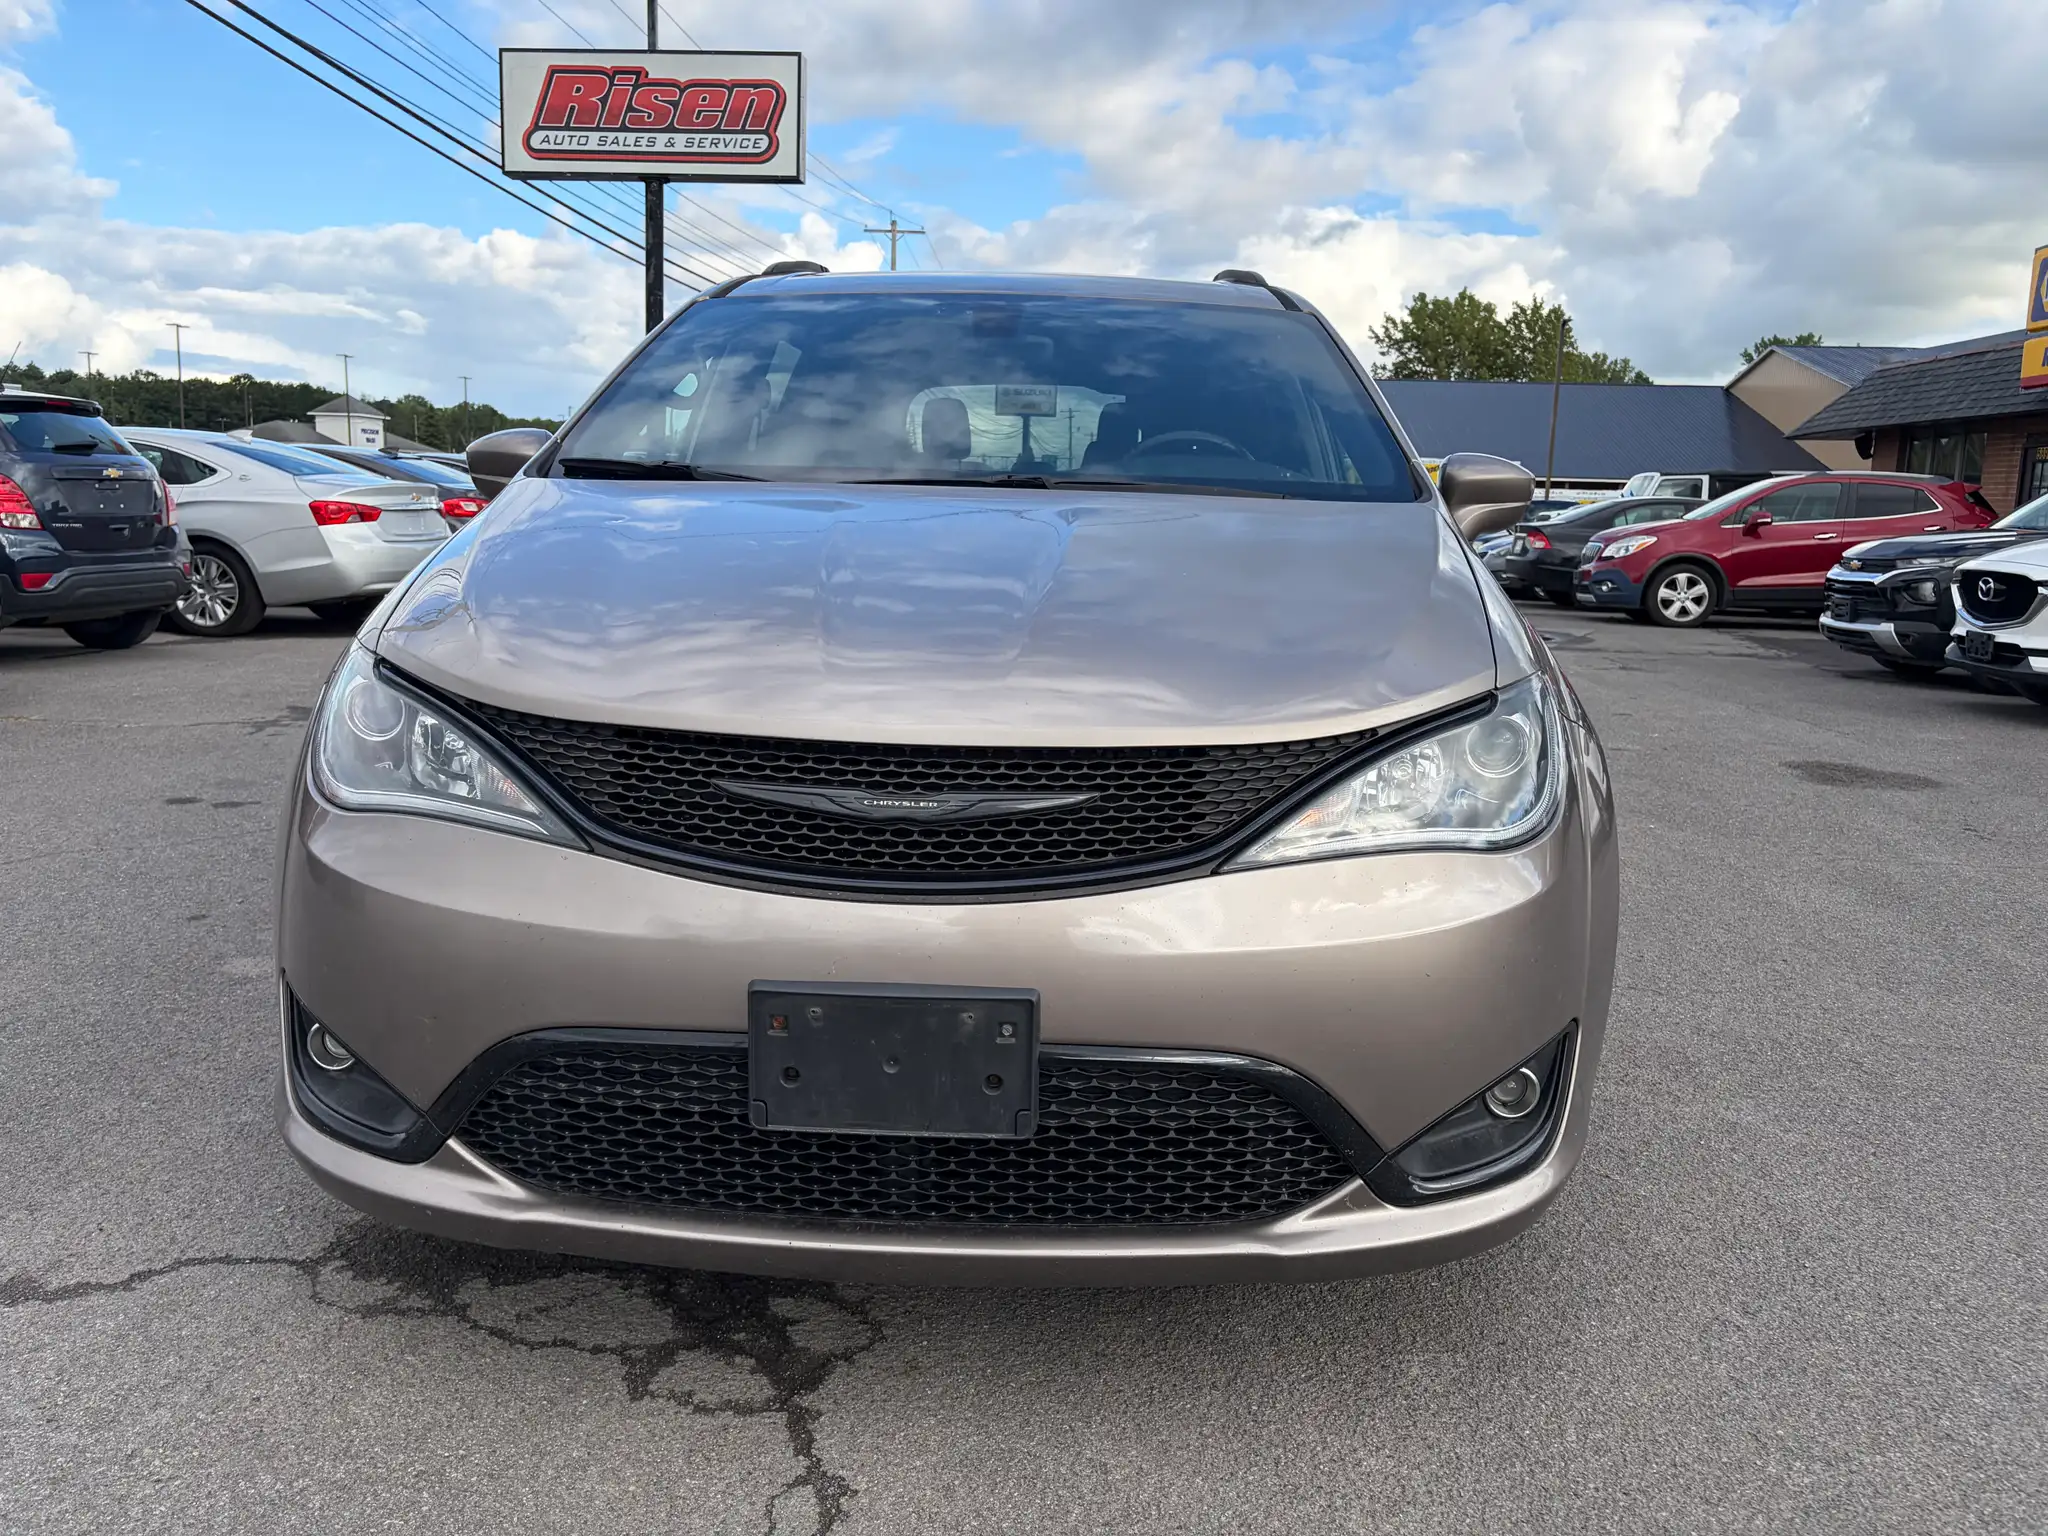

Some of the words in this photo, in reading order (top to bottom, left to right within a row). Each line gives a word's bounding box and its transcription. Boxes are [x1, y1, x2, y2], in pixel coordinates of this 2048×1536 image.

[537, 72, 777, 130] Risen
[539, 134, 589, 147] AUTO
[596, 135, 657, 148] SALES
[663, 137, 676, 148] &
[683, 137, 764, 150] SERVICE
[863, 799, 938, 807] CHRYSLER
